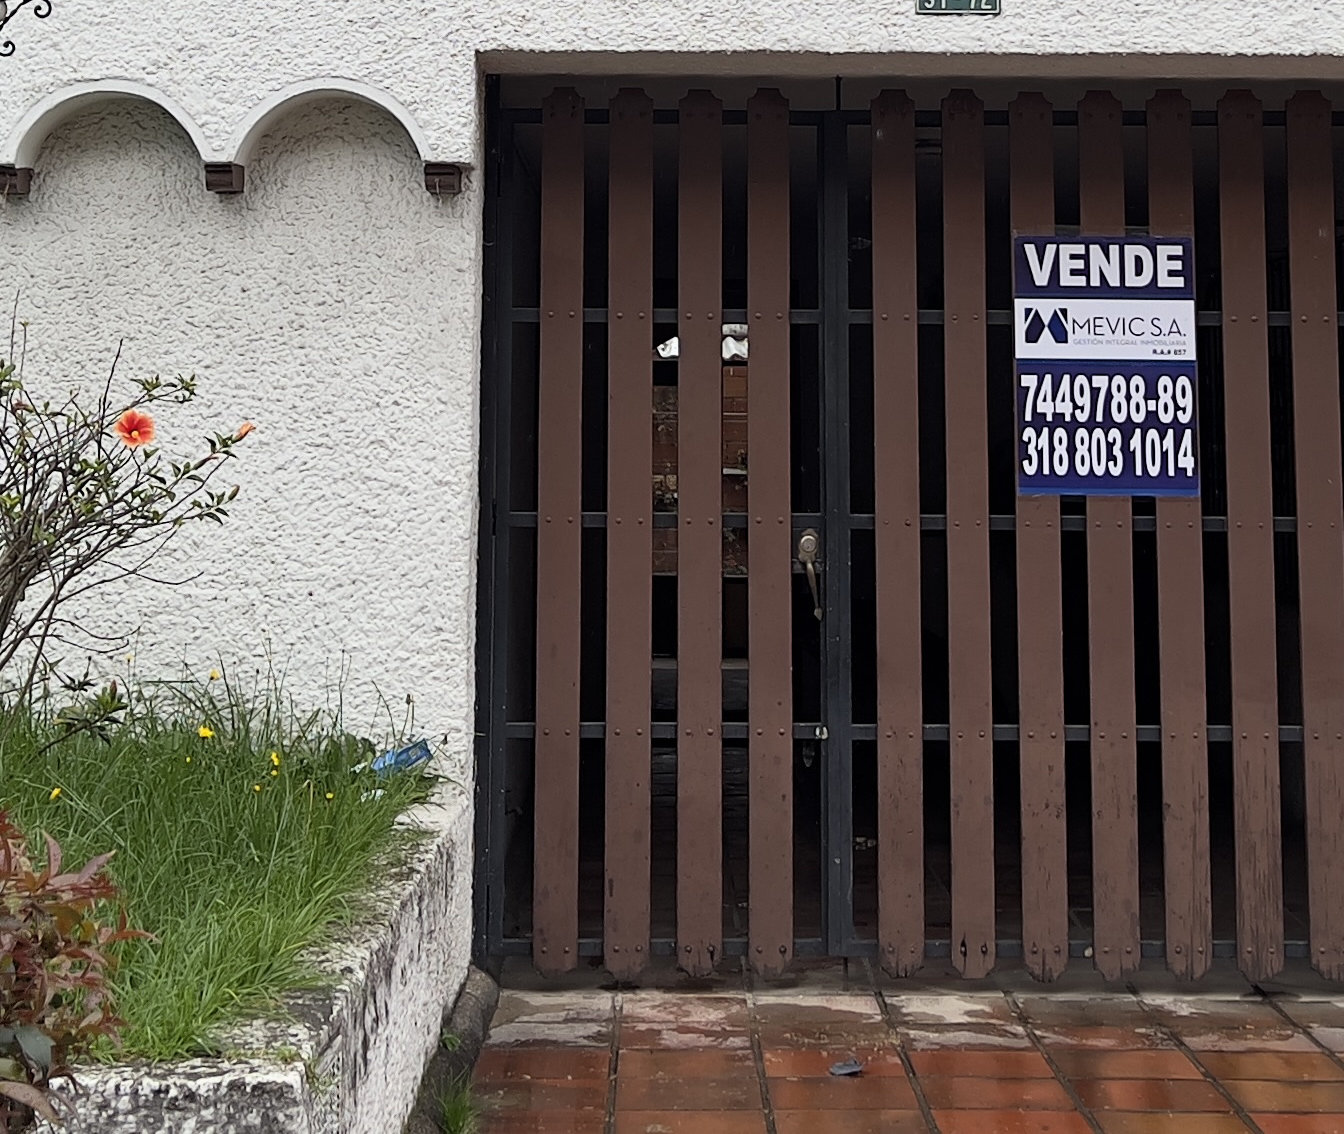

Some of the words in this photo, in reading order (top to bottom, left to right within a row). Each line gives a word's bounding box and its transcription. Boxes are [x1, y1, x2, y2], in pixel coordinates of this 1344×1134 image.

[1023, 243, 1185, 288] VENDE
[1072, 316, 1145, 337] MEVIC
[1150, 317, 1187, 337] S.A.
[1072, 337, 1104, 346] GESTIÓN
[1020, 373, 1193, 424] 7449788-89
[1022, 426, 1069, 476] 318
[1074, 427, 1124, 477] 803
[1129, 428, 1195, 477] 1014
